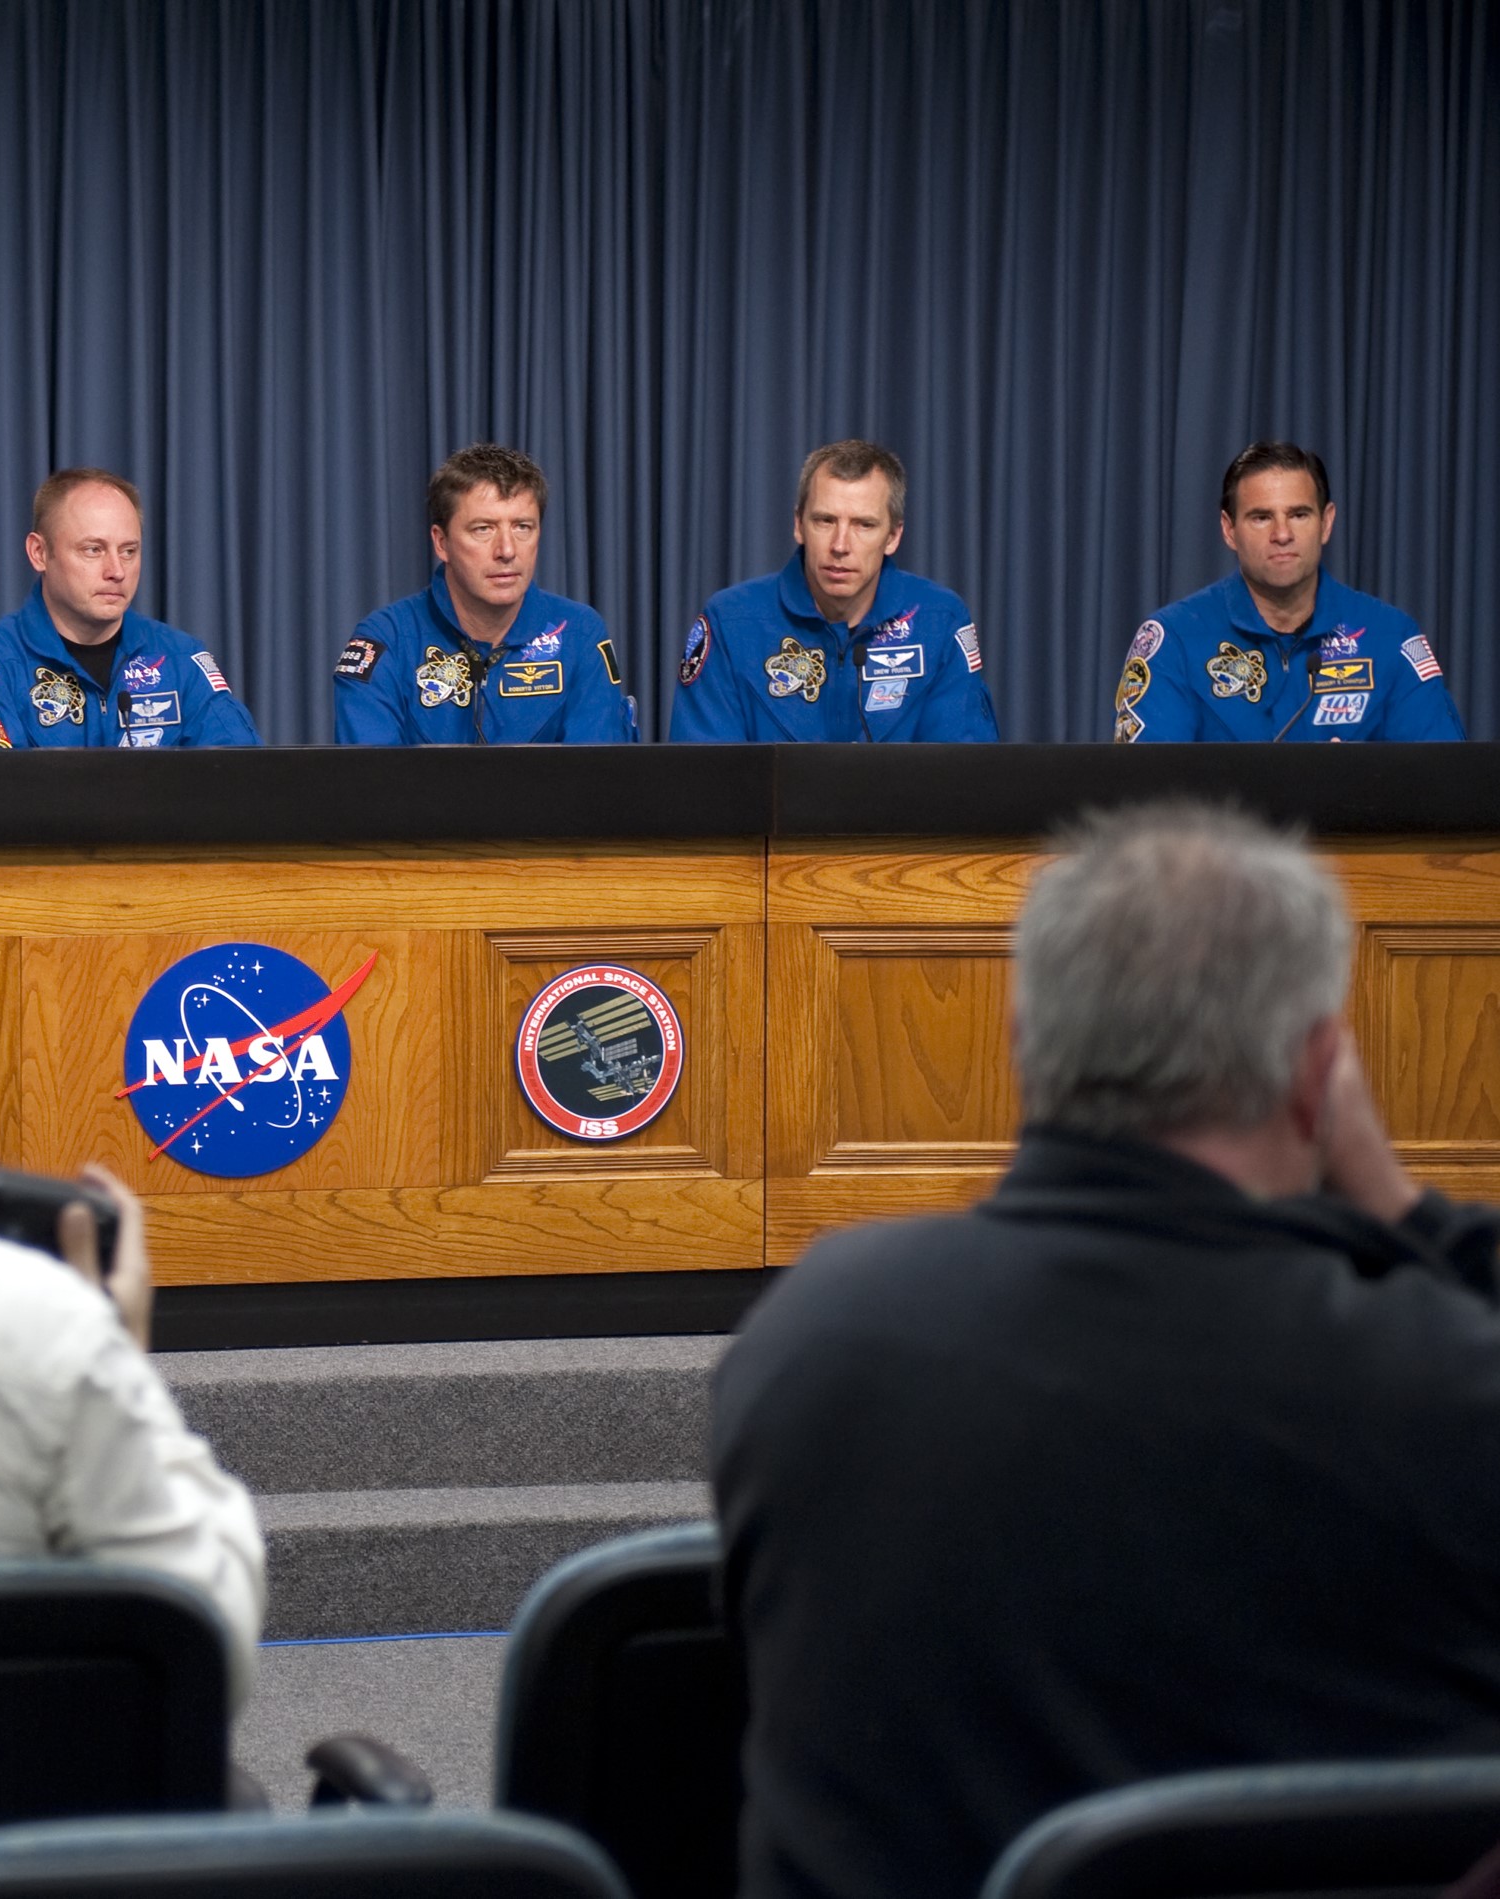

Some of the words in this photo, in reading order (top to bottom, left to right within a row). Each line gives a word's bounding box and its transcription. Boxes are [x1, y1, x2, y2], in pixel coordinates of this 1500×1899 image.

[1320, 636, 1358, 648] NASA
[123, 666, 162, 680] NASA
[524, 973, 601, 1052] INTERNATIONAL
[603, 972, 649, 997] SPACE
[647, 995, 677, 1051] STATION
[142, 1034, 340, 1086] NASA
[578, 1119, 620, 1137] ISS
